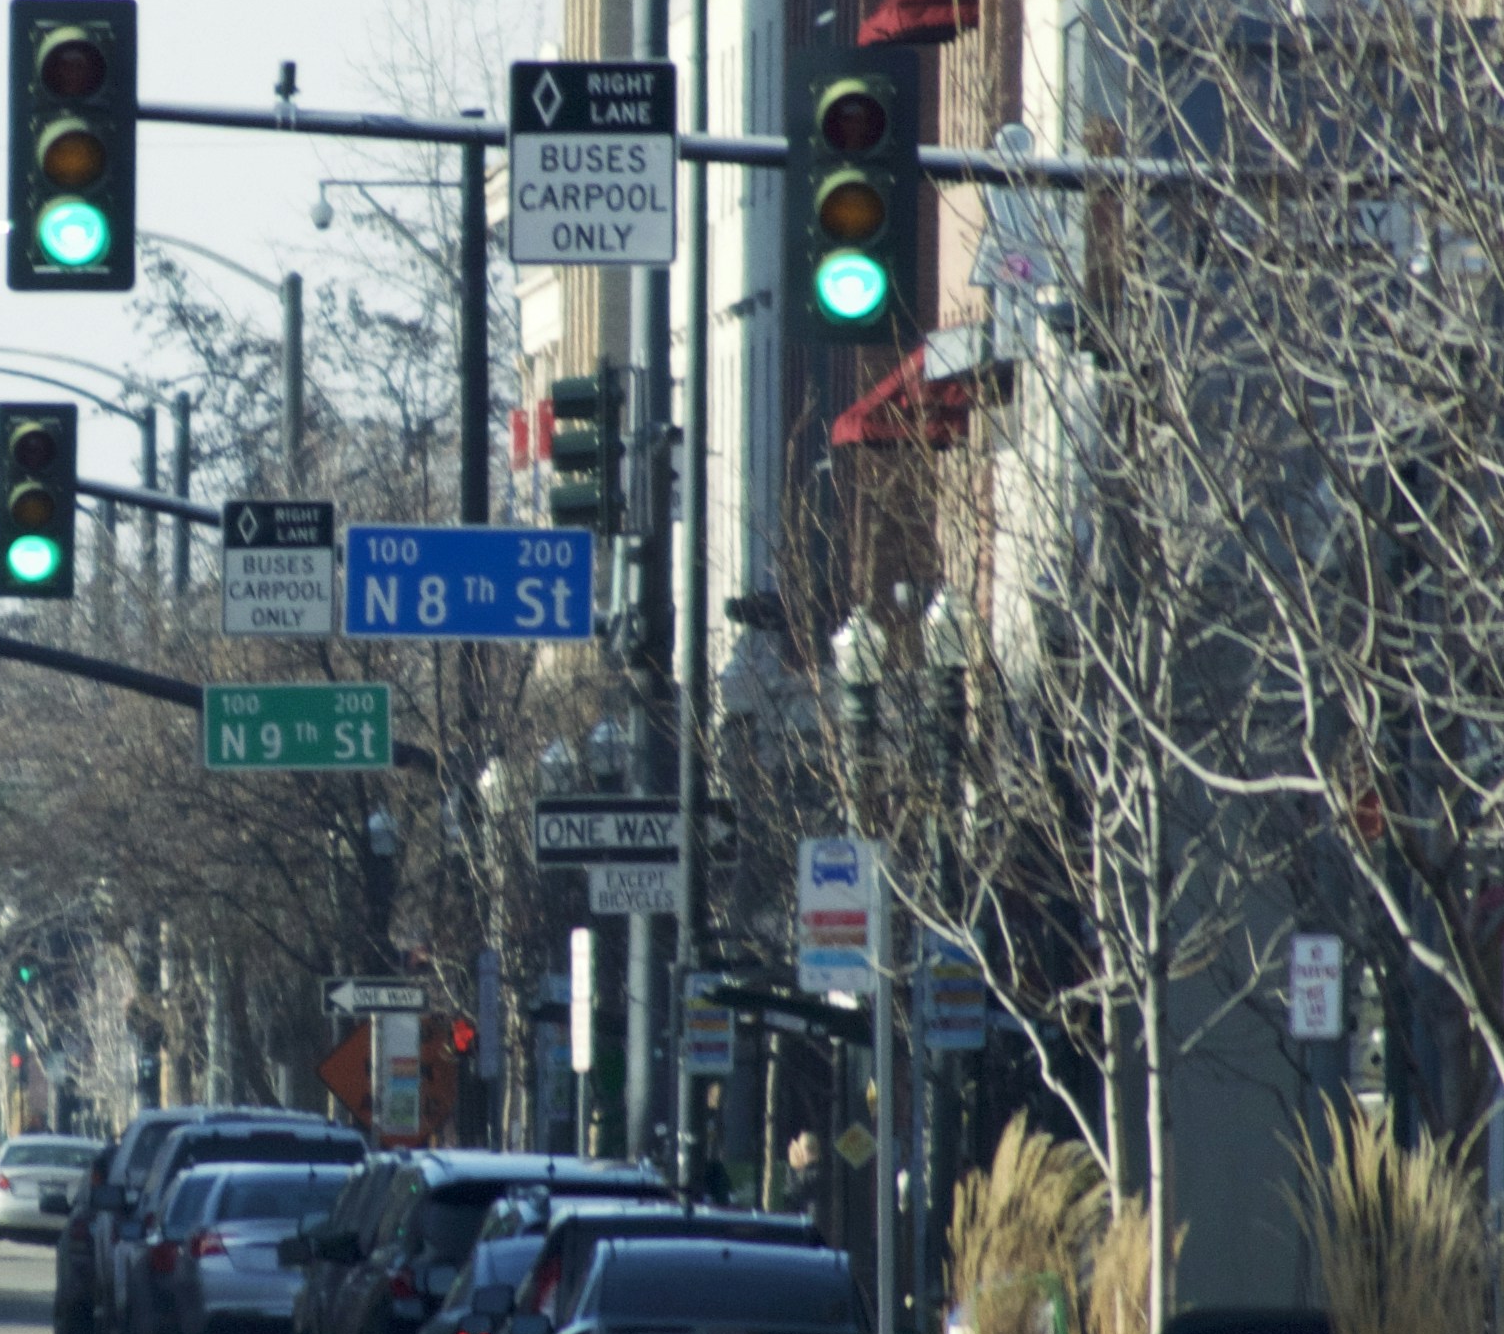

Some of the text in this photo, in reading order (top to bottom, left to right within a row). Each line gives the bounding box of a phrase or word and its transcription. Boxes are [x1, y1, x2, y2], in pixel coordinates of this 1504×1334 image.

[586, 72, 655, 97] RIGHT
[590, 100, 652, 126] LANE
[541, 143, 647, 174] BUSES
[518, 182, 667, 213] CARPOOL
[552, 222, 633, 253] ONLY
[274, 507, 321, 522] RIGHT
[276, 527, 319, 543] LANE
[242, 554, 314, 575] BUSES
[367, 537, 573, 567] 100 200
[229, 581, 329, 601] CARPOOL
[364, 574, 572, 628] N 8 Th St
[251, 608, 306, 628] ONLY
[221, 692, 376, 715] 100 200
[220, 723, 246, 761] N
[259, 723, 283, 761] 9
[333, 722, 377, 760] St
[544, 816, 674, 847] ONE WAY
[604, 871, 666, 889] EXCEPT
